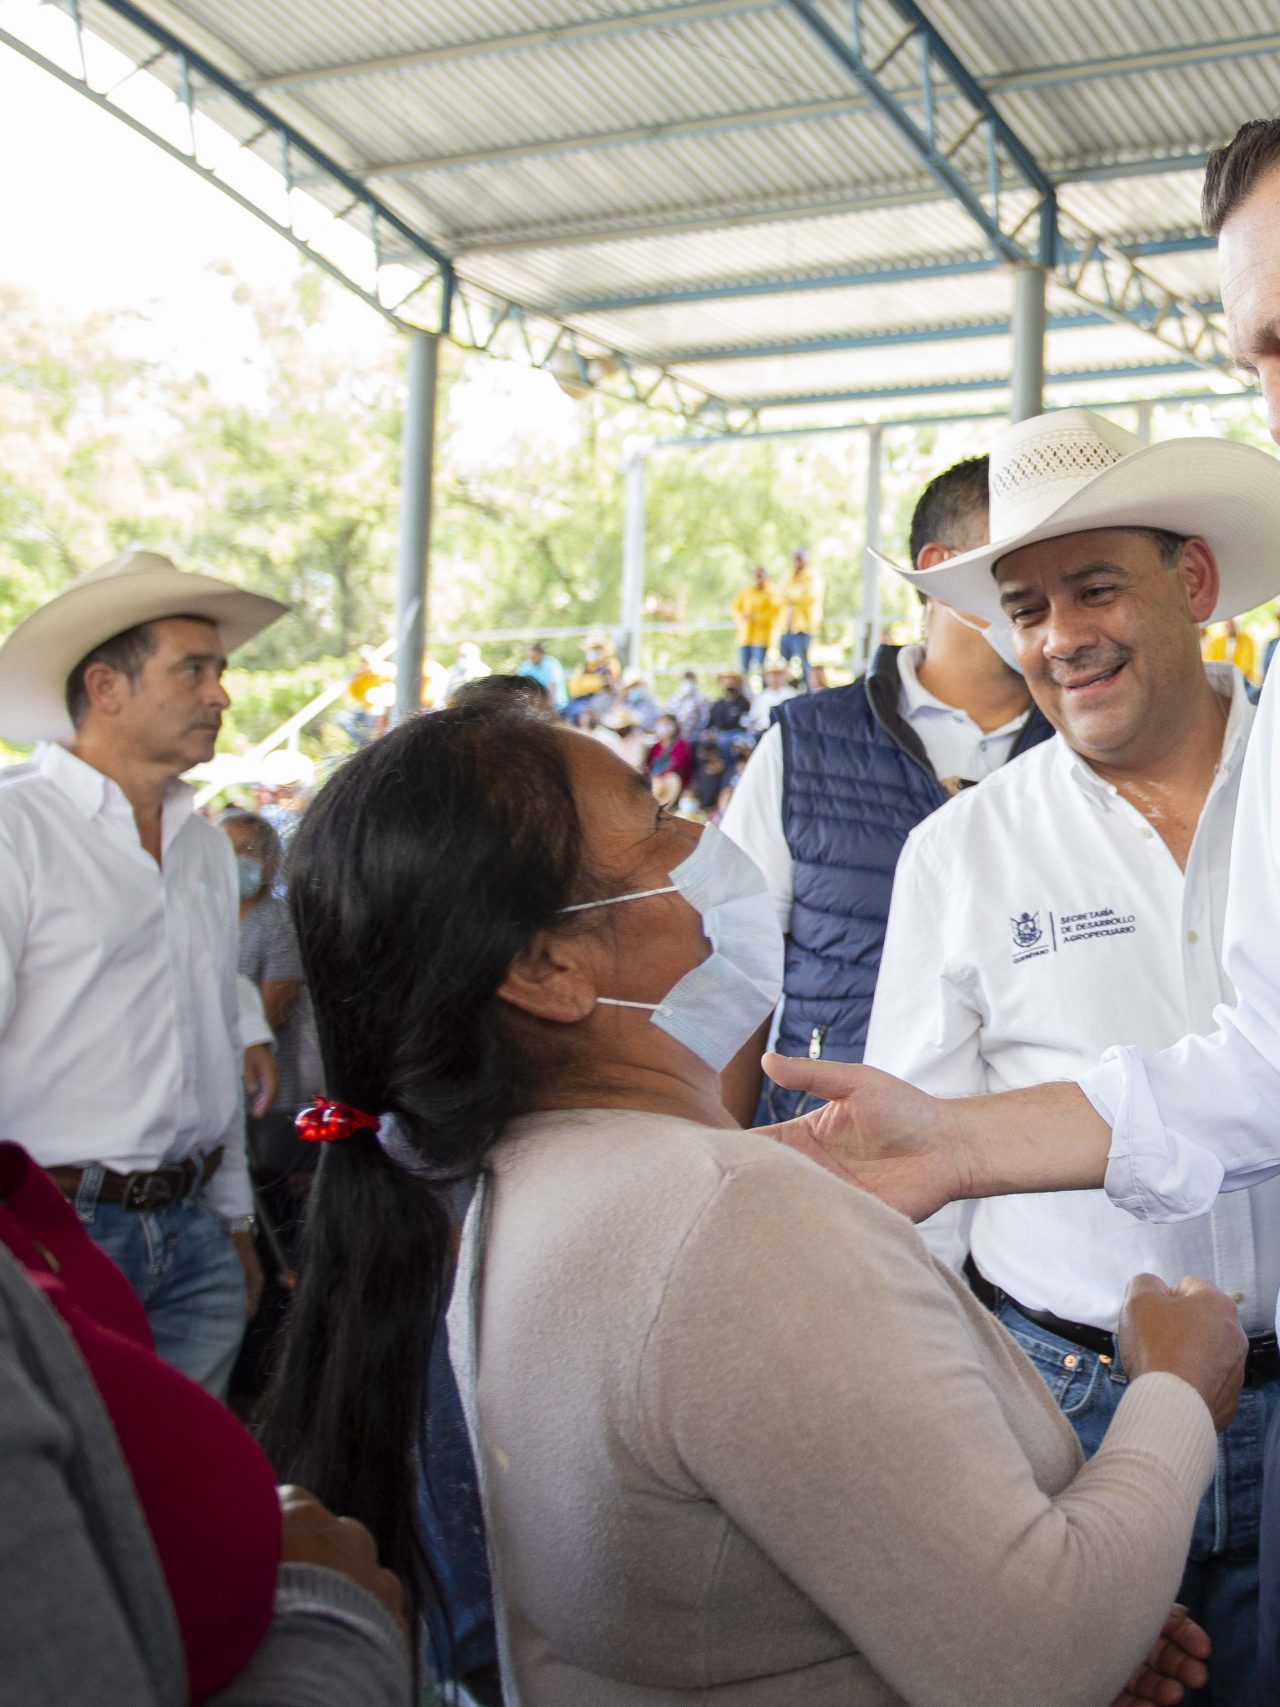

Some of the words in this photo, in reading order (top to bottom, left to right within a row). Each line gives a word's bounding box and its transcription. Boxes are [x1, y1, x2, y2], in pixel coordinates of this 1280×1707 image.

[1060, 907, 1114, 924] SECRETARÍA
[1061, 926, 1073, 934] DE
[1076, 915, 1136, 931] DESARROLLO
[1063, 926, 1136, 944] AGROPECUARIO
